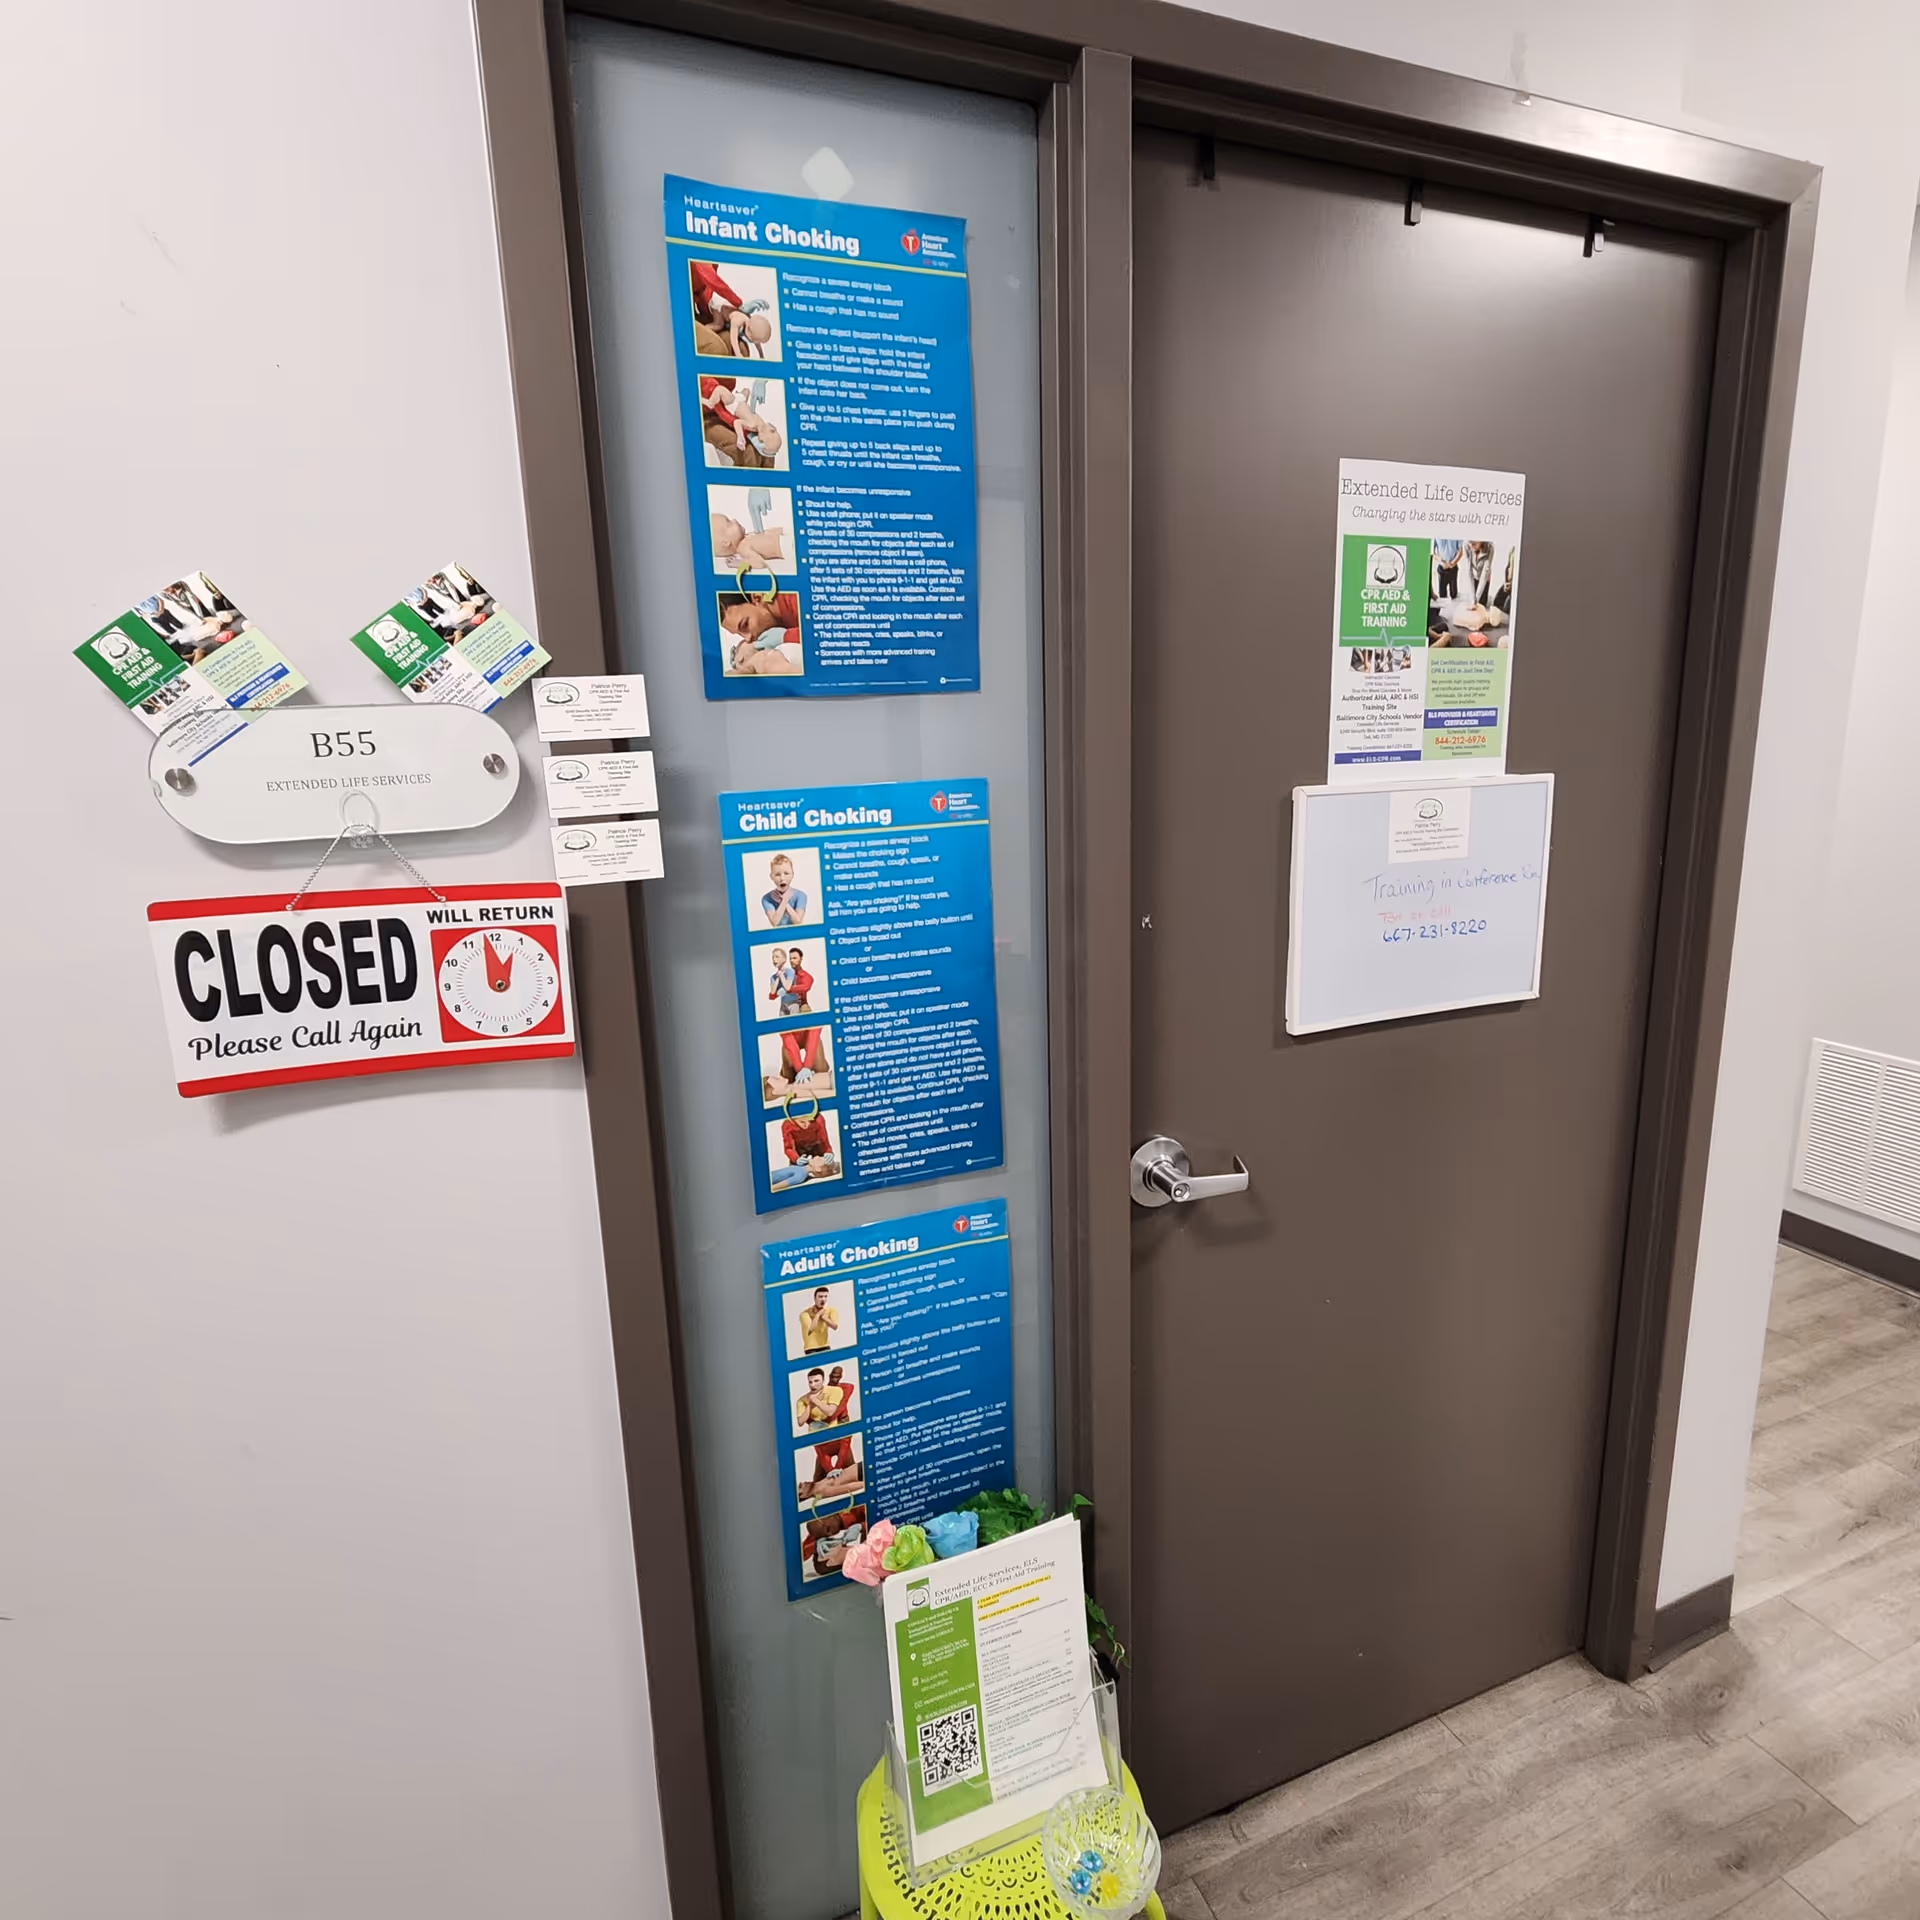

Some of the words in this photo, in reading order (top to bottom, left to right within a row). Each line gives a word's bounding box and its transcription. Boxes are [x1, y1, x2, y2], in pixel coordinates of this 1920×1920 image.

[684, 195, 757, 214] Heartsaver
[686, 212, 758, 240] Infant
[765, 222, 860, 256] Choking
[1341, 478, 1418, 499] Extended
[1424, 484, 1454, 501] Life
[1460, 486, 1522, 506] Services
[1352, 506, 1406, 522] Changing
[1408, 509, 1426, 521] the
[1429, 511, 1456, 523] stars
[1459, 513, 1481, 524] with
[1484, 515, 1510, 526] CPR!
[1360, 589, 1381, 600] CPR
[1381, 589, 1401, 601] AED
[1402, 589, 1410, 601] &
[1363, 602, 1388, 614] FIRST
[1390, 603, 1406, 614] AID
[1361, 616, 1407, 627] TRAINING
[392, 647, 410, 663] FIRST
[409, 638, 421, 651] AID
[128, 652, 142, 666] AED
[397, 644, 429, 670] TRAINING
[121, 664, 142, 681] FIRST
[141, 656, 154, 668] AID
[127, 662, 163, 689] TRAINING
[1374, 694, 1388, 702] AHA,
[1390, 693, 1403, 701] ARC
[1362, 704, 1385, 712] Training
[1336, 714, 1365, 722] Baltimore
[1366, 714, 1378, 722] City
[311, 731, 375, 757] B55
[1434, 735, 1486, 745] 844-212-6976
[266, 777, 336, 792] EXTENDED
[340, 775, 369, 788] LIFE
[373, 773, 432, 786] SERVICES
[737, 801, 802, 812] Heartsaver
[740, 812, 797, 832] Child
[804, 806, 892, 826] Choking
[1362, 871, 1435, 904] Training
[1441, 871, 1451, 888] in
[427, 909, 473, 923] WILL
[480, 906, 553, 921] RETURN
[489, 933, 501, 942] 12
[518, 937, 523, 946] 1
[462, 940, 474, 949] 11
[445, 958, 458, 968] 10
[537, 953, 544, 962] 2
[174, 918, 418, 1022] CLOSED
[444, 982, 451, 991] 9
[547, 976, 554, 985] 3
[454, 1004, 461, 1013] 8
[542, 1000, 549, 1008] 4
[475, 1020, 482, 1029] 7
[526, 1017, 533, 1026] 5
[501, 1024, 508, 1033] 6
[188, 1033, 281, 1060] Please
[292, 1021, 341, 1047] Call
[349, 1018, 422, 1050] Again
[780, 1254, 835, 1276] Adult
[840, 1236, 919, 1263] Choking
[935, 1580, 972, 1598] Extended
[973, 1573, 987, 1585] Life
[989, 1564, 1022, 1578] Services,
[1023, 1556, 1038, 1567] ELS
[935, 1589, 972, 1606] CPR/AED,
[973, 1583, 987, 1594] ECC
[988, 1580, 994, 1588] &
[995, 1575, 1012, 1586] First
[1013, 1570, 1025, 1580] Aid
[1026, 1560, 1056, 1574] Training
